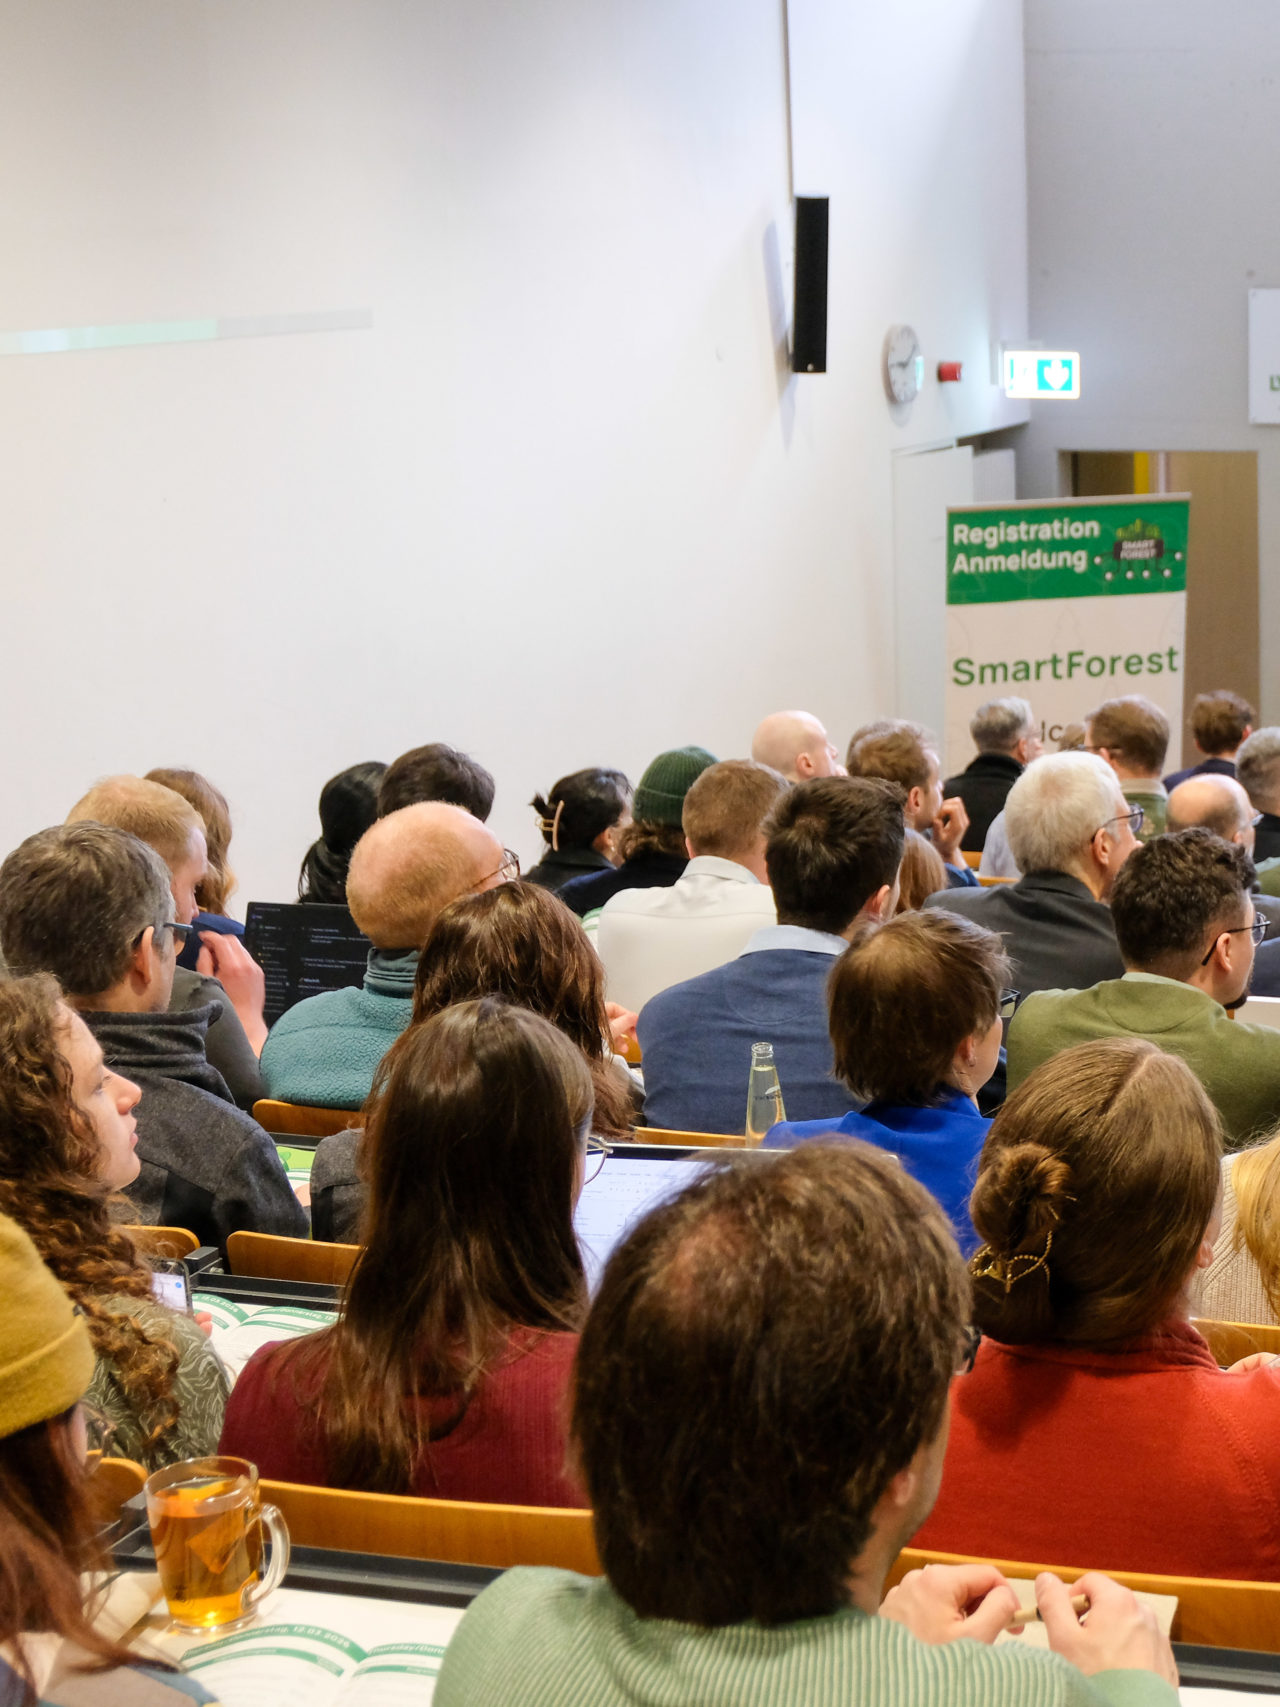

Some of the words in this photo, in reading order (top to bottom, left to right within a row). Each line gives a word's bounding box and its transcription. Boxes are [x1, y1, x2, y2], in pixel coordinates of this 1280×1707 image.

[952, 518, 1100, 548] Registration
[1121, 539, 1155, 549] SMART
[952, 548, 1088, 574] Anmeldung
[1120, 548, 1156, 560] FOREST
[951, 646, 1179, 686] SmartForest
